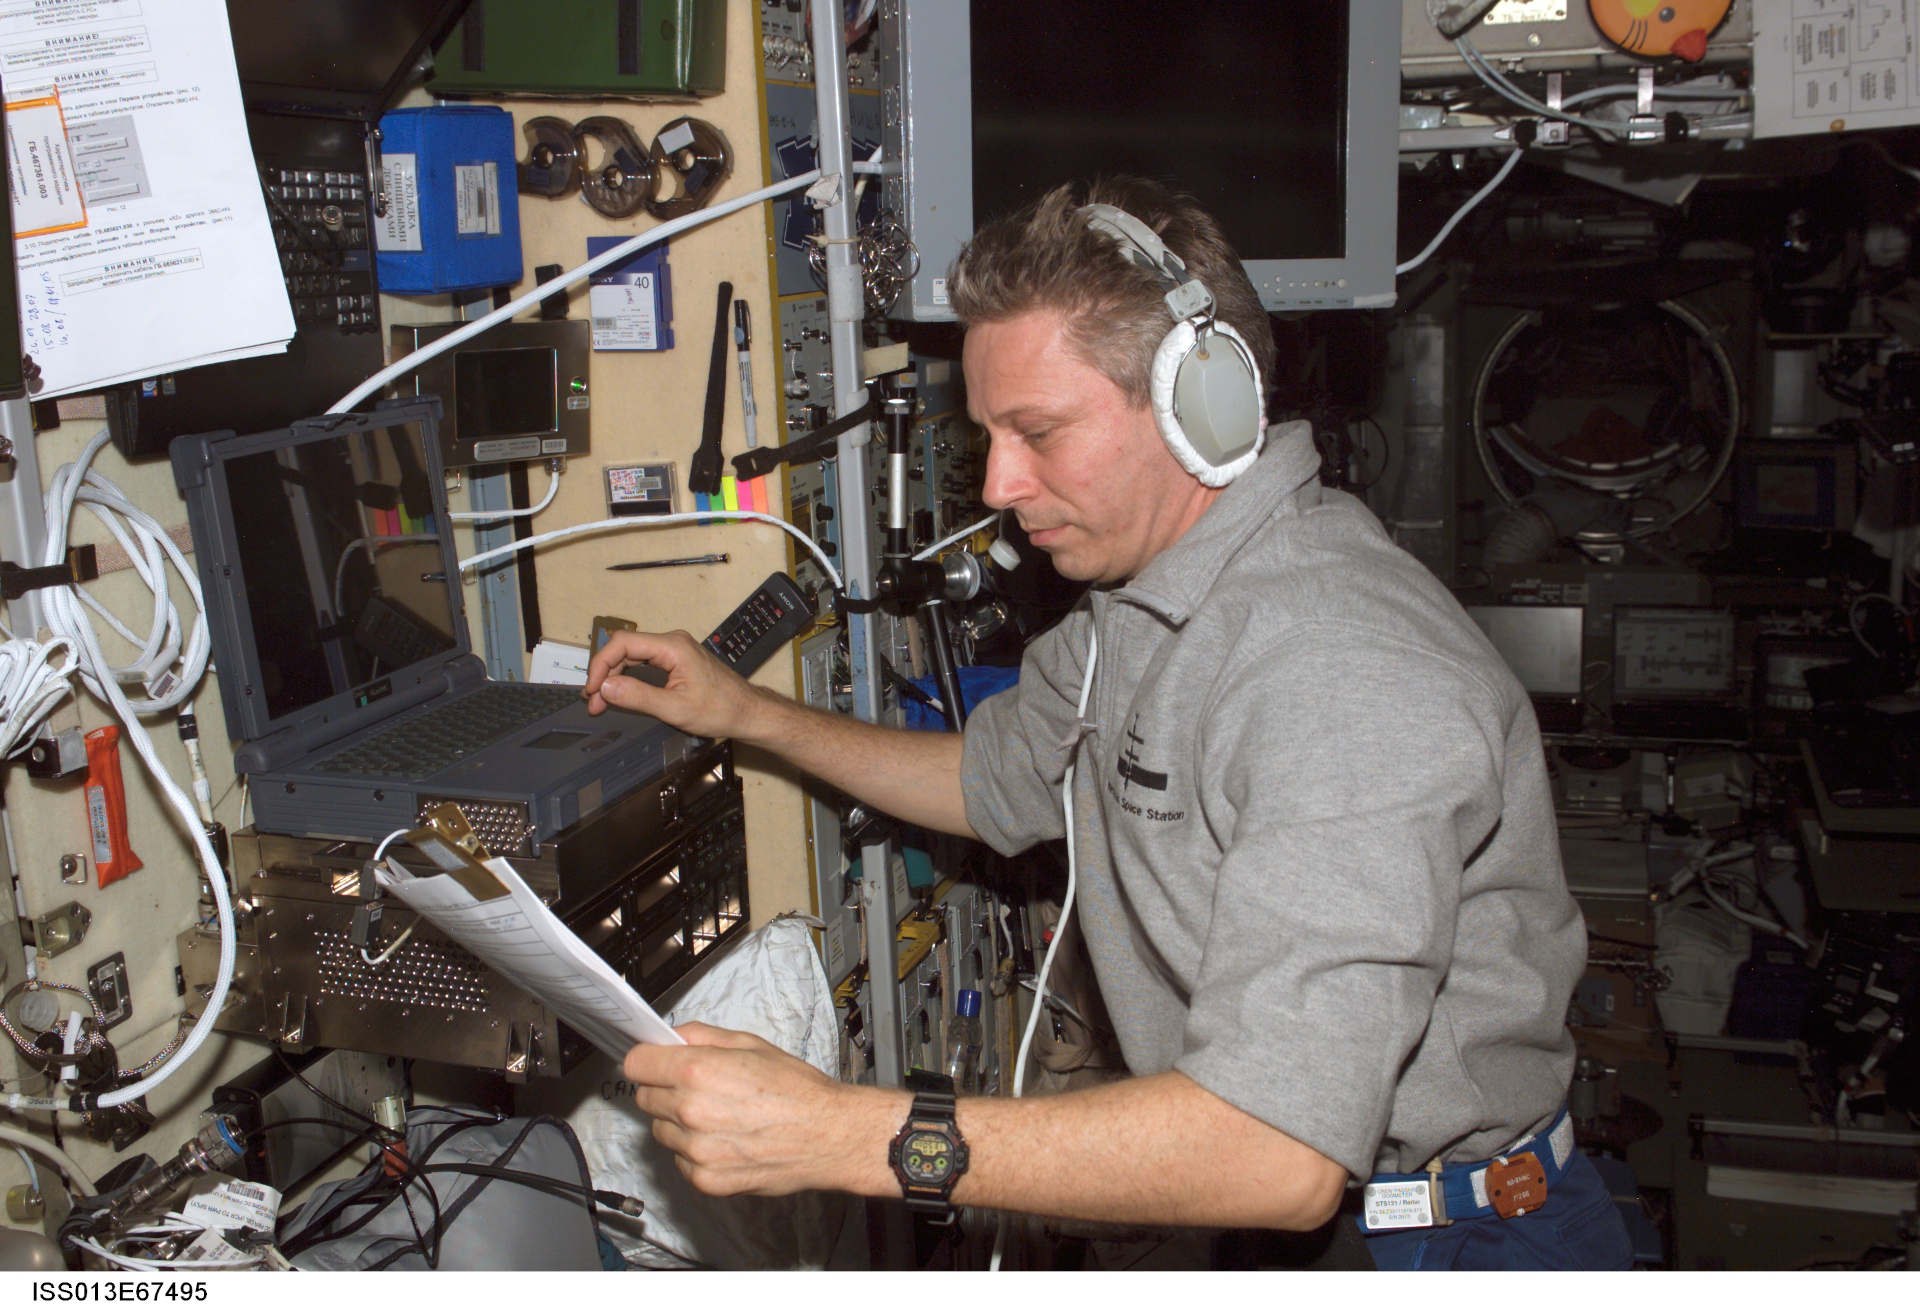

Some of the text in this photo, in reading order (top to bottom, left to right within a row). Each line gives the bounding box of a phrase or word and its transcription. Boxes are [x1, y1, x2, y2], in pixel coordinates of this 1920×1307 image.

[394, 172, 406, 242] ПИЩЕВЫМИ
[406, 174, 416, 230] УКЛАДКА
[634, 276, 650, 289] 40
[1146, 808, 1184, 822] Station
